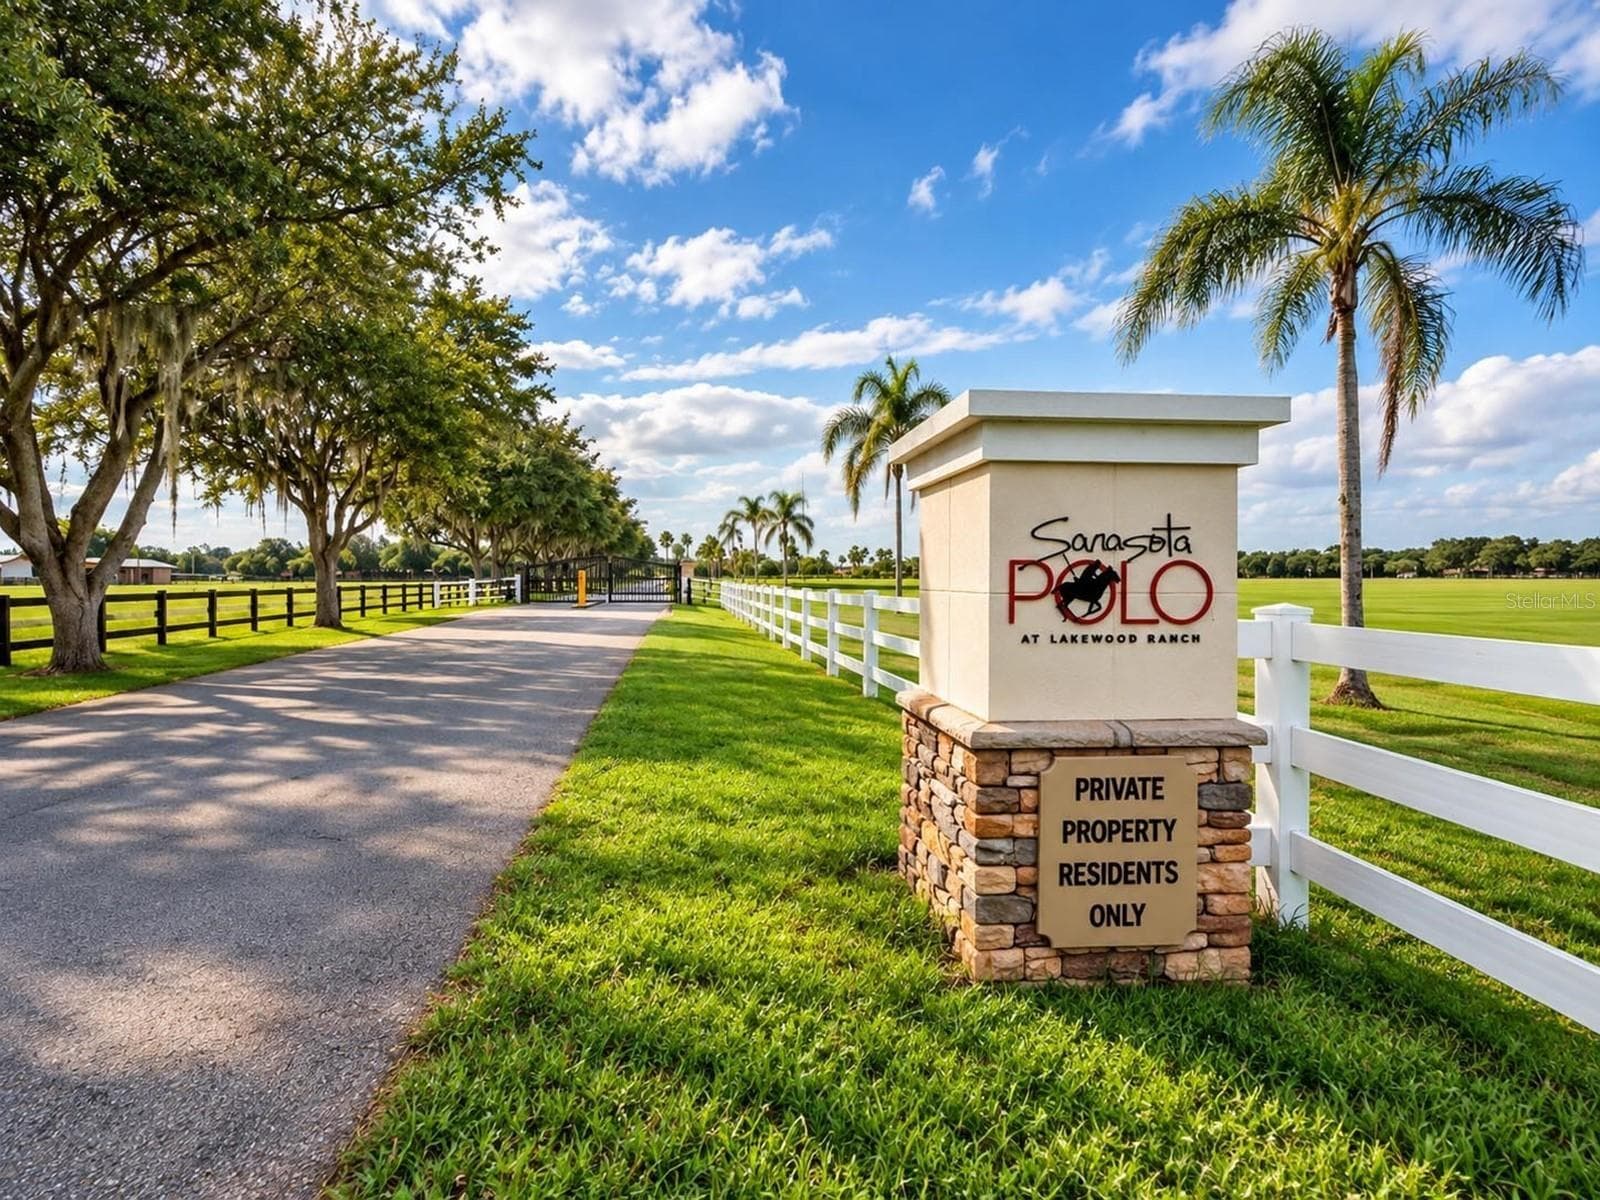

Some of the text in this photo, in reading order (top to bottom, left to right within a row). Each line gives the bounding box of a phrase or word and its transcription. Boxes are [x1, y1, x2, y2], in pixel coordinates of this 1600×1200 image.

[1008, 559, 1214, 625] POLO
[1021, 634, 1201, 644] AT LAKEWOOD RANCH
[1075, 776, 1165, 801] PRIVATE
[1062, 818, 1177, 844] PROPERTY
[1058, 860, 1179, 887] RESIDENTS
[1089, 903, 1146, 928] ONLY
